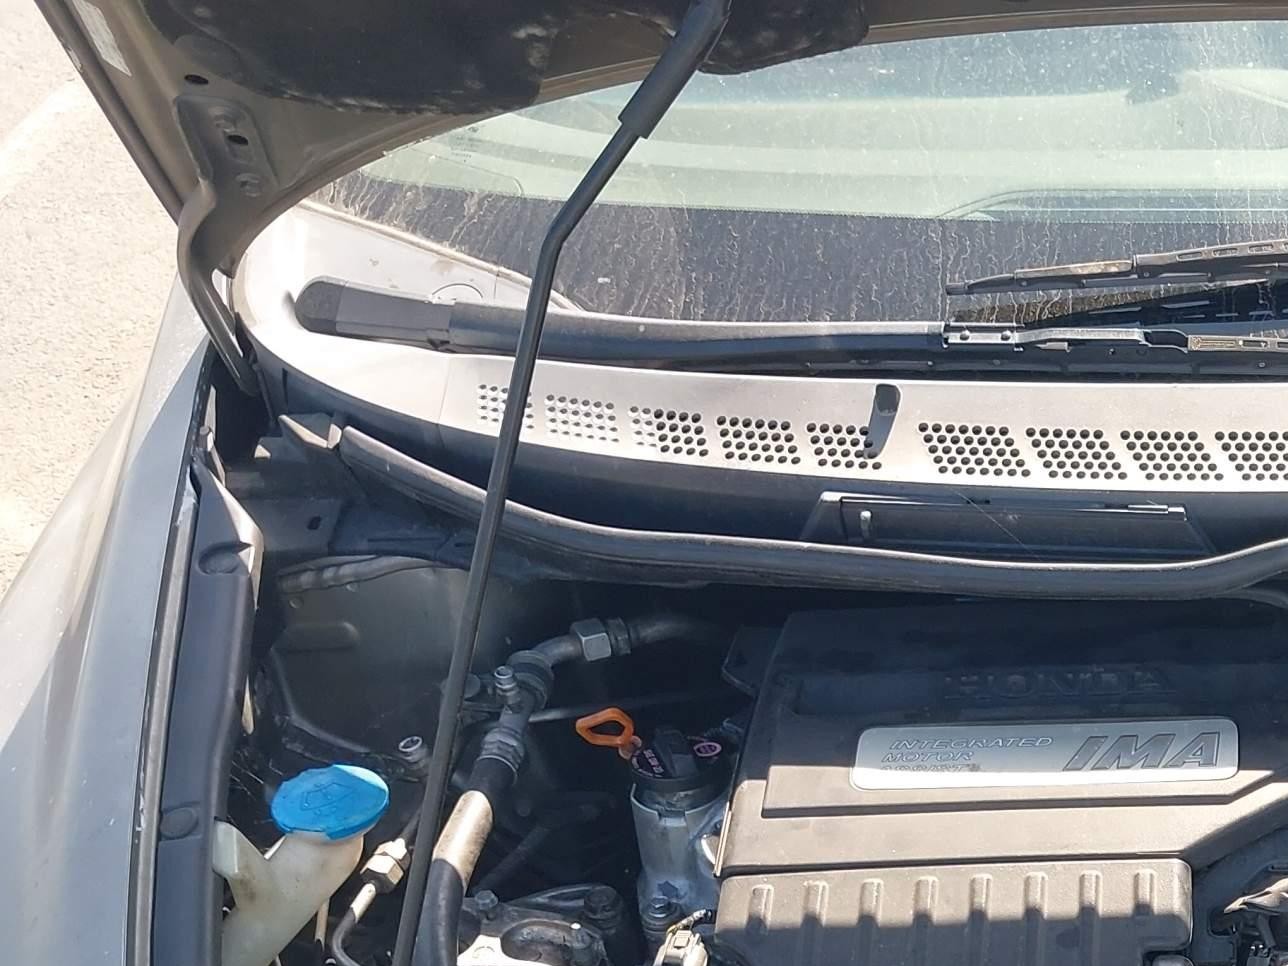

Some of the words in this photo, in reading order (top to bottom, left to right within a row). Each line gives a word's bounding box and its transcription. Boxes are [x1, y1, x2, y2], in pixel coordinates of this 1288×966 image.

[944, 671, 1177, 699] HONDA
[889, 736, 1053, 750] INTEGRATED
[1063, 731, 1221, 772] IMA
[881, 751, 974, 763] MOTOR
